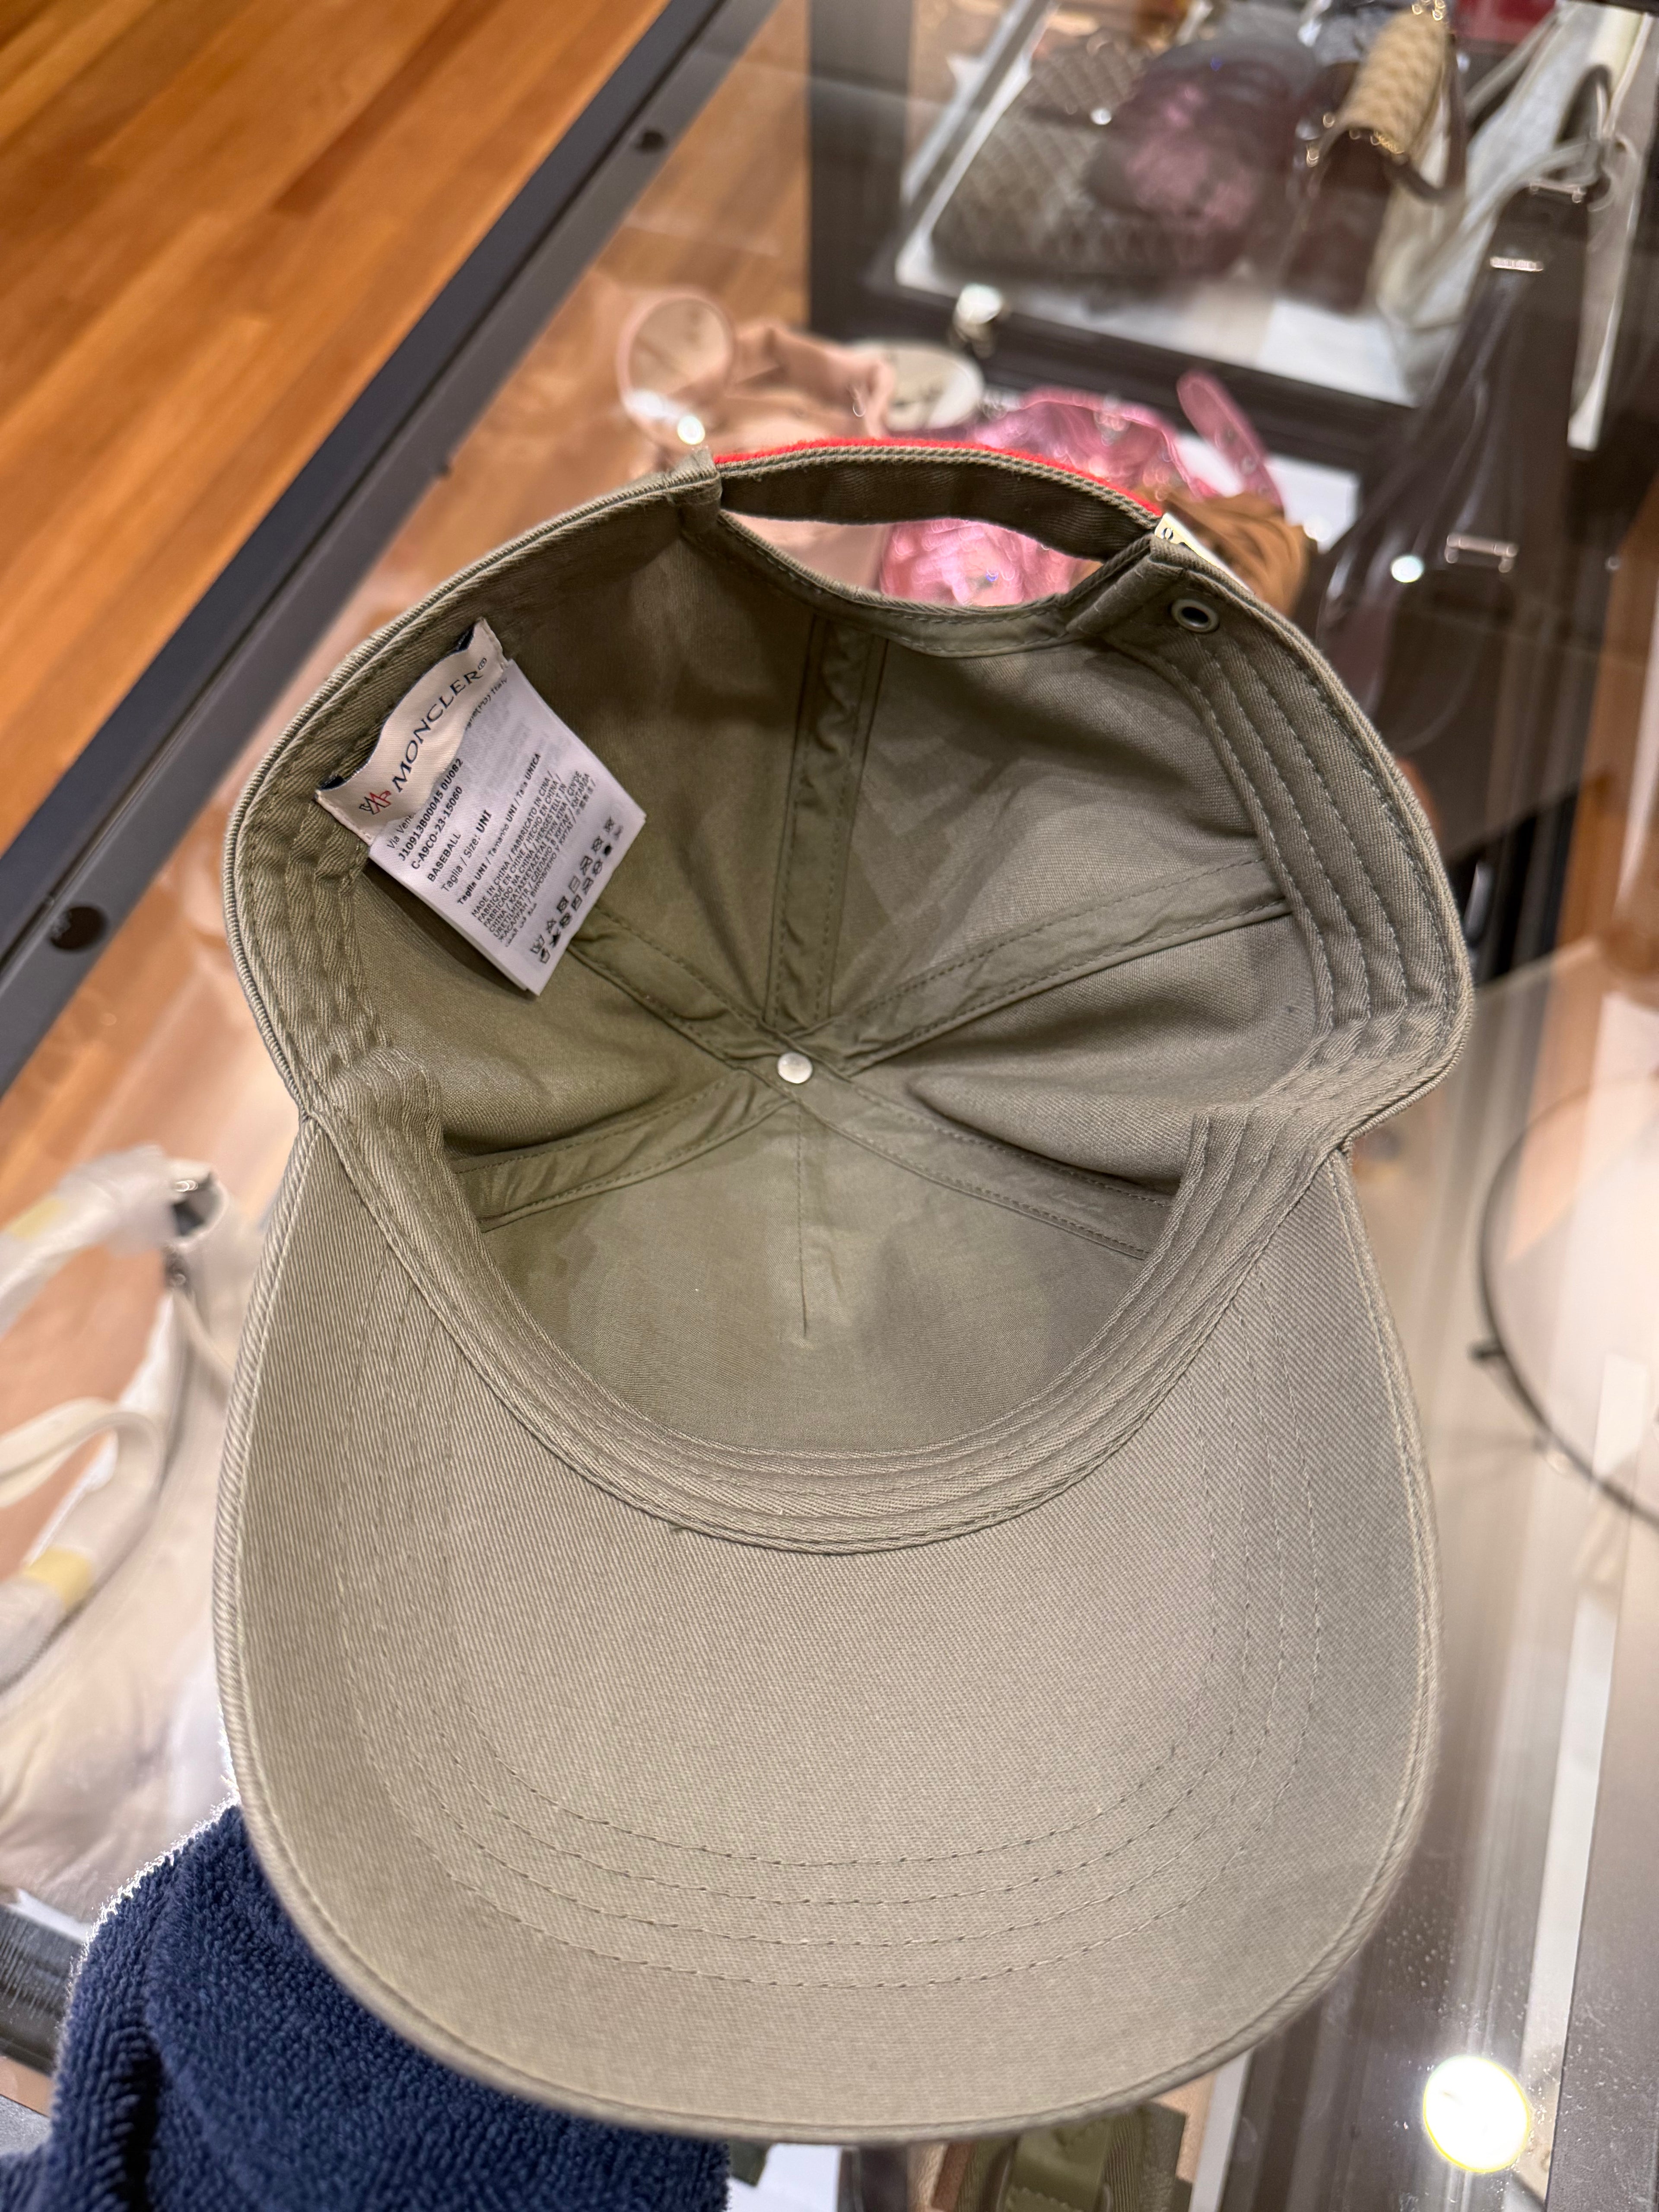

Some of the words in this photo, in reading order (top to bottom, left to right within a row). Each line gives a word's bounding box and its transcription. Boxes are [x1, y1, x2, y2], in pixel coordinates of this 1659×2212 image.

[386, 835, 400, 849] Via
[398, 789, 444, 861] J10913B00045
[440, 758, 464, 791] 0U082
[426, 833, 461, 882] BASEBALL
[440, 864, 464, 892] Taglia
[463, 834, 481, 858] Size:
[475, 809, 492, 833] UNI
[457, 881, 477, 905] Taglia
[474, 862, 488, 881] UNI
[487, 823, 509, 857] Tamanho
[505, 804, 518, 823] UNI
[524, 753, 541, 780] UNICA
[471, 895, 489, 918] MADE
[486, 885, 496, 896] IN
[493, 861, 511, 886] CHINA
[510, 807, 537, 856] FABBRICATO
[533, 796, 542, 808] IN
[538, 777, 551, 797] CINA
[483, 885, 514, 928] FABRICADO
[511, 874, 521, 886] NA
[518, 849, 535, 874] CHINA
[534, 792, 562, 844] HERGESTELLT
[558, 783, 567, 795] IN
[502, 873, 512, 886] EN
[509, 849, 526, 874] CHINE
[525, 816, 543, 844] HECHO
[539, 804, 548, 817] EN
[544, 780, 559, 805] CHINA
[489, 909, 508, 933] CHINA
